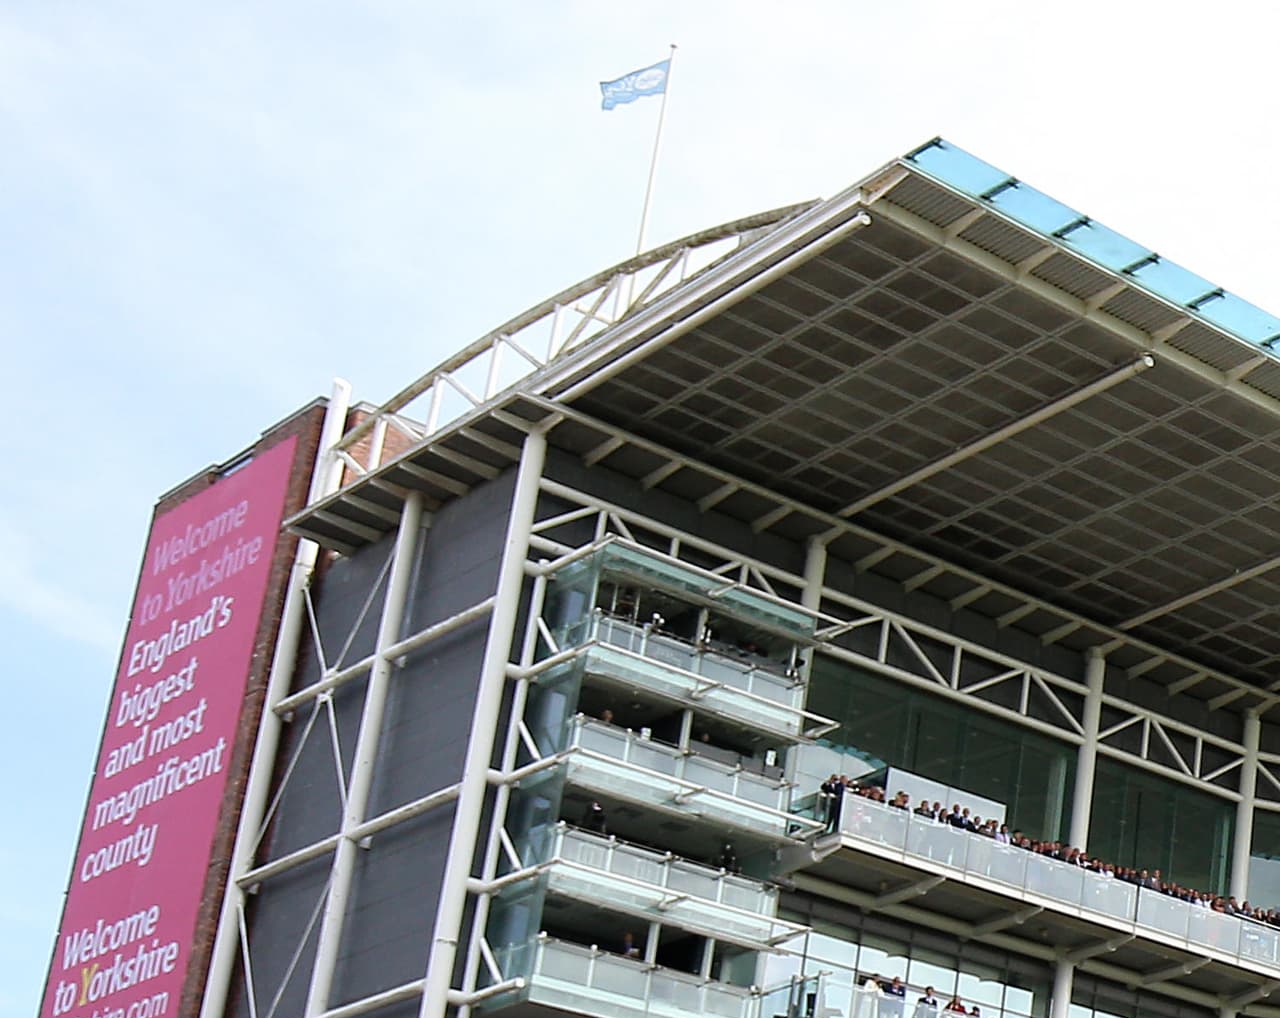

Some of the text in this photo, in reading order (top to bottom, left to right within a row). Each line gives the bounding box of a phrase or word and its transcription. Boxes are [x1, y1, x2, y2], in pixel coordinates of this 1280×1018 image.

[153, 500, 248, 576] Welcome
[140, 536, 263, 626] to Yorkshire
[127, 595, 234, 678] England's
[116, 657, 198, 727] biggest
[104, 698, 208, 778] and most
[92, 737, 227, 830] magnificent
[81, 824, 159, 882] county
[63, 905, 160, 970] Welcome
[53, 939, 179, 1016] to Yorkshire
